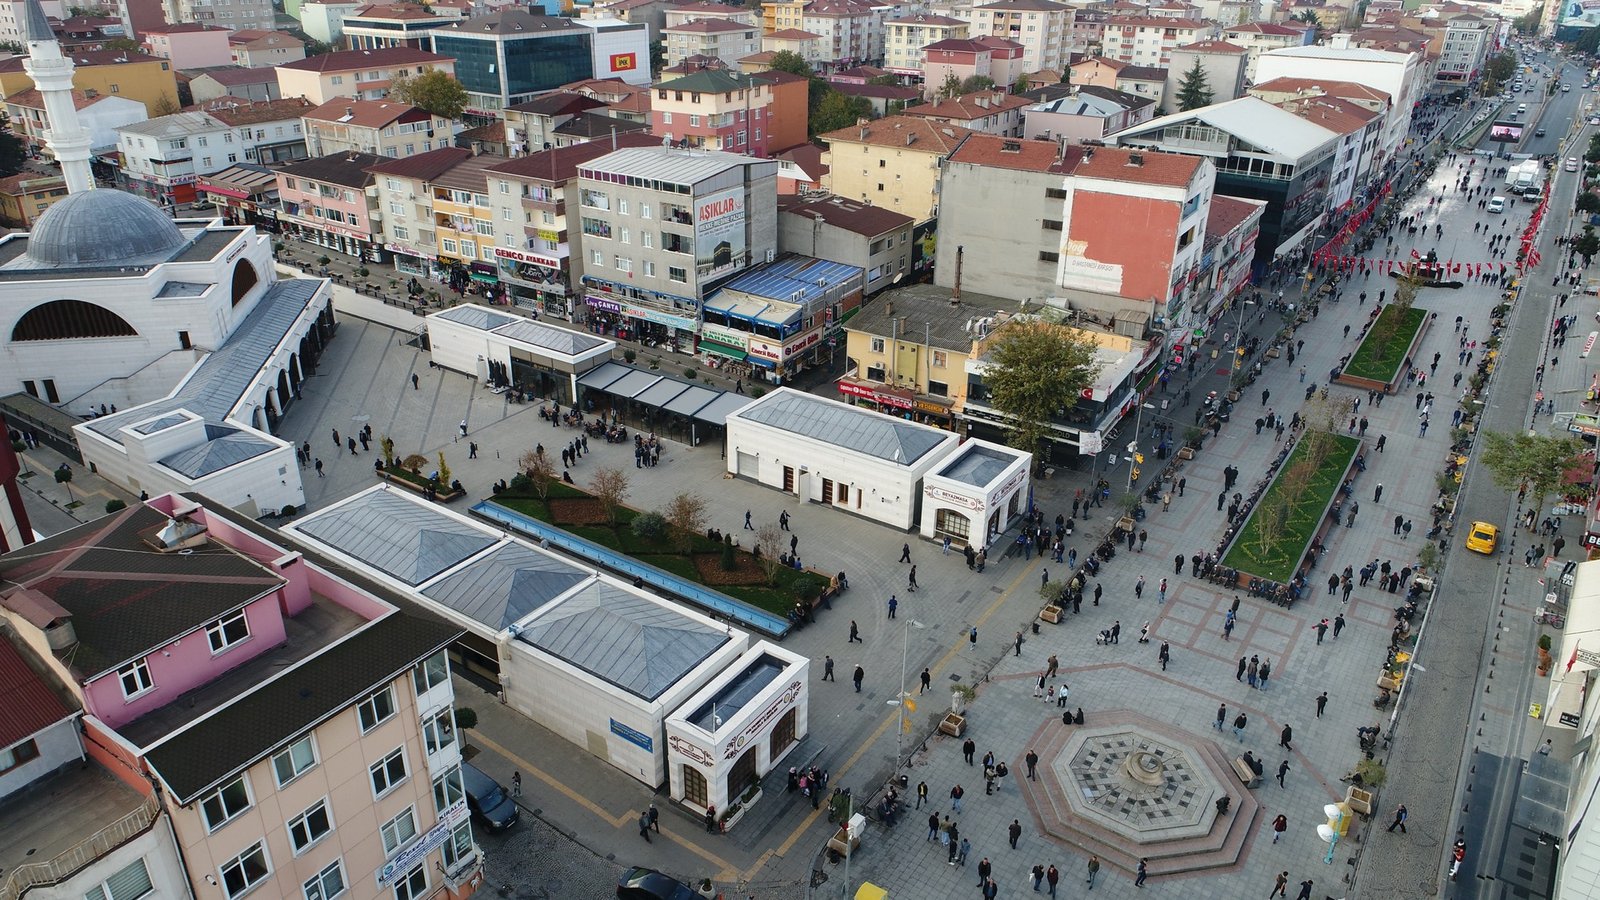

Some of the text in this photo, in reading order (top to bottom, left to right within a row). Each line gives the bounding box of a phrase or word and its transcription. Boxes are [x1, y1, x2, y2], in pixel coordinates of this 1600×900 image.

[699, 197, 734, 221] AŞIKLAR
[598, 301, 619, 311] ÇANTA
[702, 332, 747, 348] BAHARAT
[439, 800, 465, 820] KIRALIK
